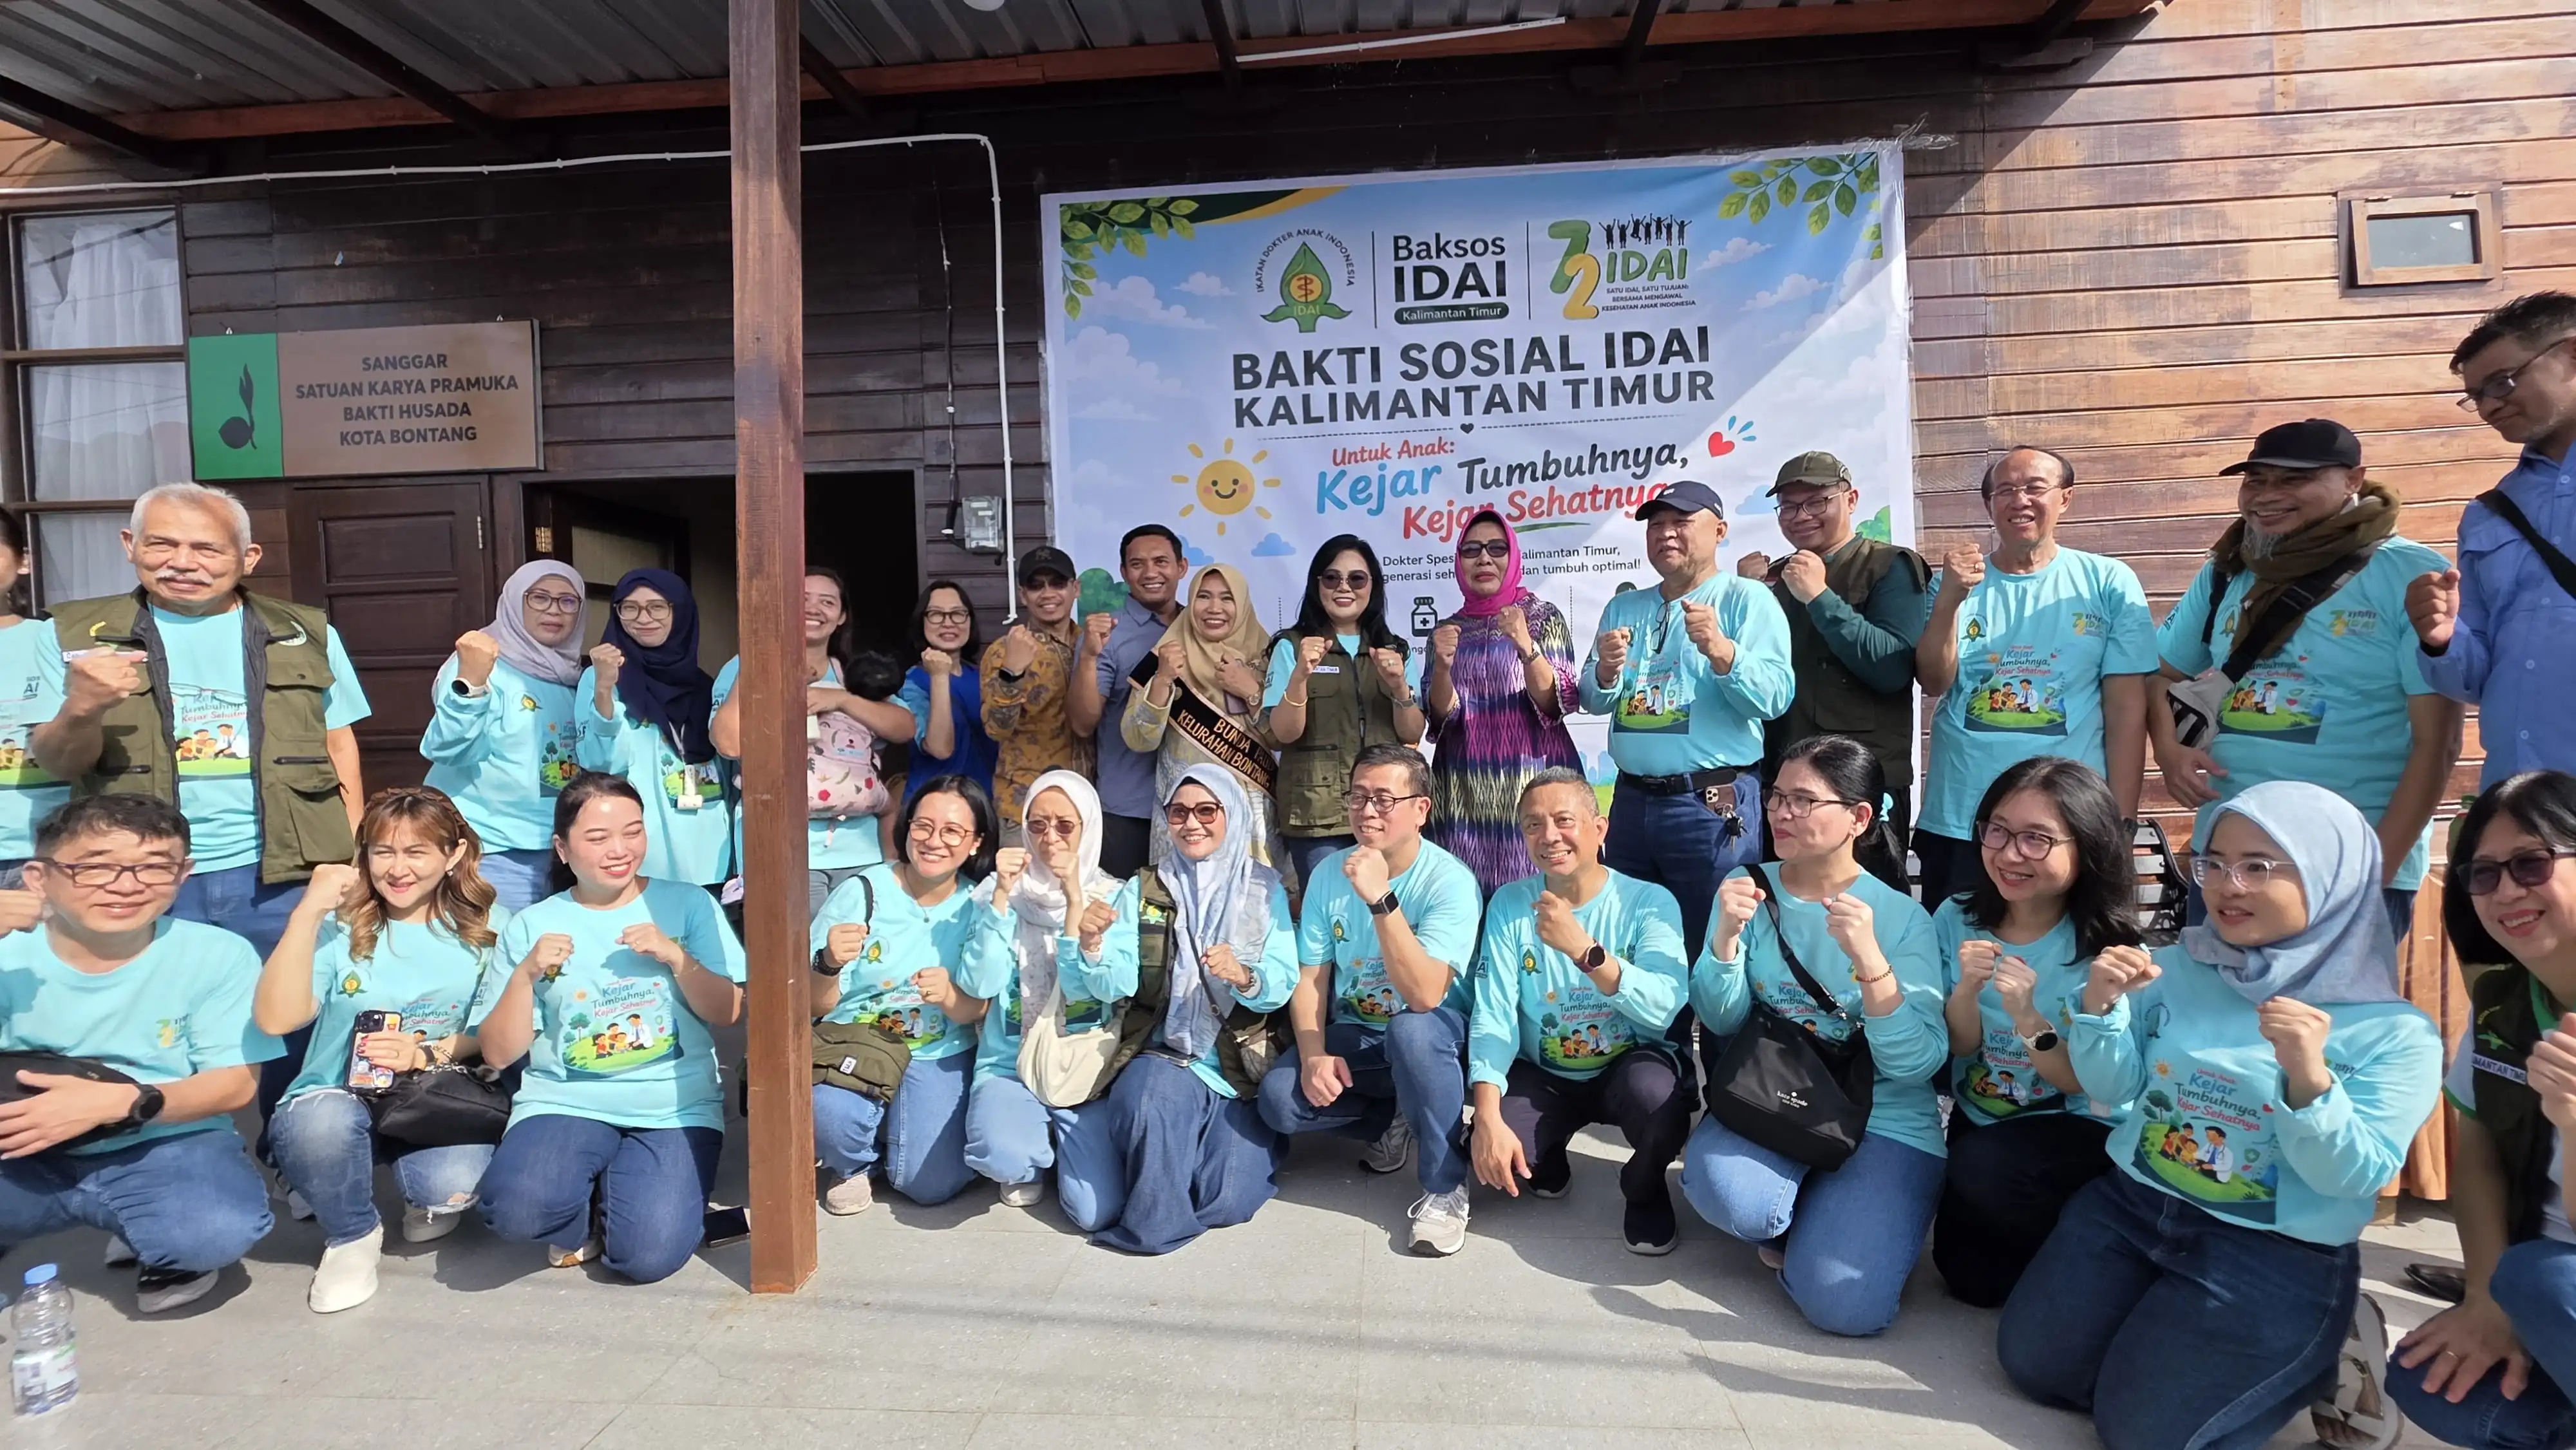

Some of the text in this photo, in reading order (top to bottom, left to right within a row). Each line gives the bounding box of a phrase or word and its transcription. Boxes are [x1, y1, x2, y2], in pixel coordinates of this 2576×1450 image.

[1392, 232, 1506, 262] Baksos
[1255, 229, 1356, 292] IKATAN DOKTER ANAK INDONESIA
[1547, 219, 1601, 320] 72
[1605, 248, 1688, 284] IDAI
[1393, 260, 1508, 303] IDAI
[1293, 305, 1321, 315] IDAI
[1402, 306, 1502, 322] Kalimantan Timur
[1601, 299, 1696, 312] KESEHATAN ANAK INDONESIA
[362, 353, 448, 372] SANGGAR
[1232, 326, 1710, 391] BAKTI SOSIAL IDAI
[296, 375, 518, 399] SATUAN KARYA PRAMUKA
[1235, 370, 1715, 428] KALIMANTAN TIMUR
[343, 402, 472, 422] BAKTI HUSADA
[340, 426, 477, 446] KOTA BONTANG
[1332, 437, 1455, 467] Untuk Anak:
[1316, 442, 1689, 516] Kejar Tumbuhnya,
[1383, 546, 1620, 567] Dokter Spes alimantan Timur,
[1383, 569, 1432, 583] generasi
[1435, 569, 1455, 579] seh
[1543, 562, 1589, 574] tumbuh
[1592, 558, 1641, 574] optimal!
[2000, 658, 2050, 668] umbuhnya,
[1177, 709, 1271, 789] KELURAHAN BONTANG
[1214, 719, 1251, 753] BUNDA
[1568, 991, 1595, 1003] Kejar
[2189, 1072, 2237, 1096] Kejar
[2174, 1082, 2262, 1120] Tumbuhnya,
[2201, 1105, 2260, 1131] Sehatnya
